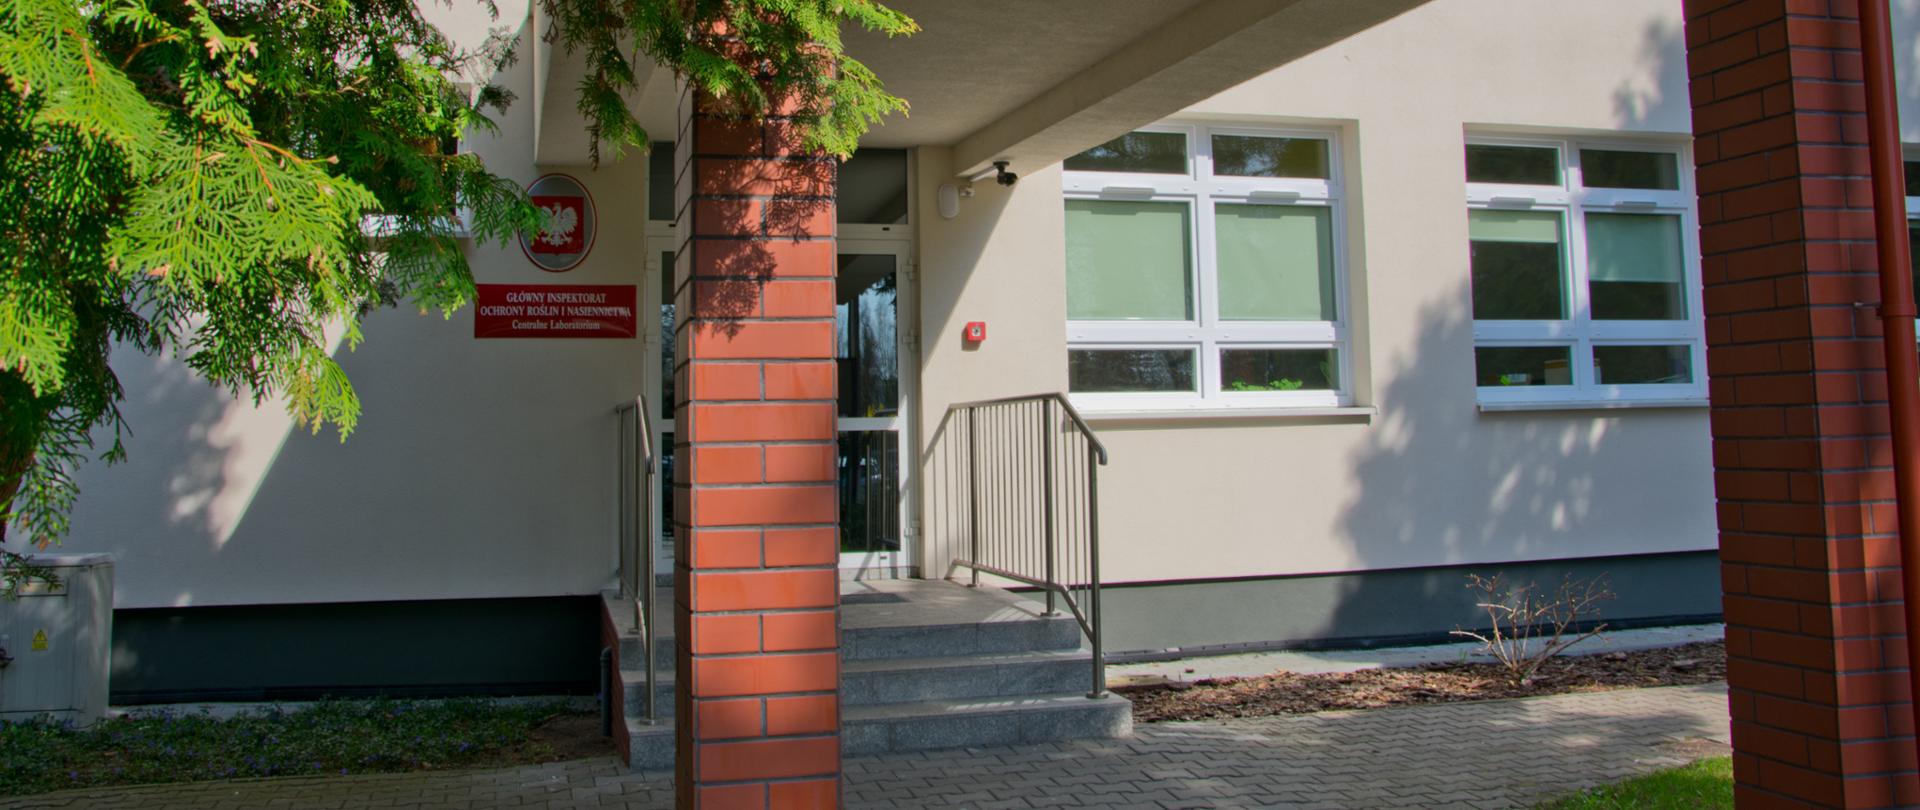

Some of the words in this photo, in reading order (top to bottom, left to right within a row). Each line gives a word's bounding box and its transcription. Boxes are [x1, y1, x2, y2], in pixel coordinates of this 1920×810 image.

[506, 291, 545, 302] GŁÓWNY
[547, 292, 607, 303] INSPEKTORAT
[480, 305, 525, 316] OCHRONY
[527, 303, 559, 316] ROŚLIN
[561, 305, 565, 316] I
[567, 306, 631, 317] NASIENNICTWA
[512, 320, 548, 329] Centralne
[550, 320, 600, 330] Laboratorium
